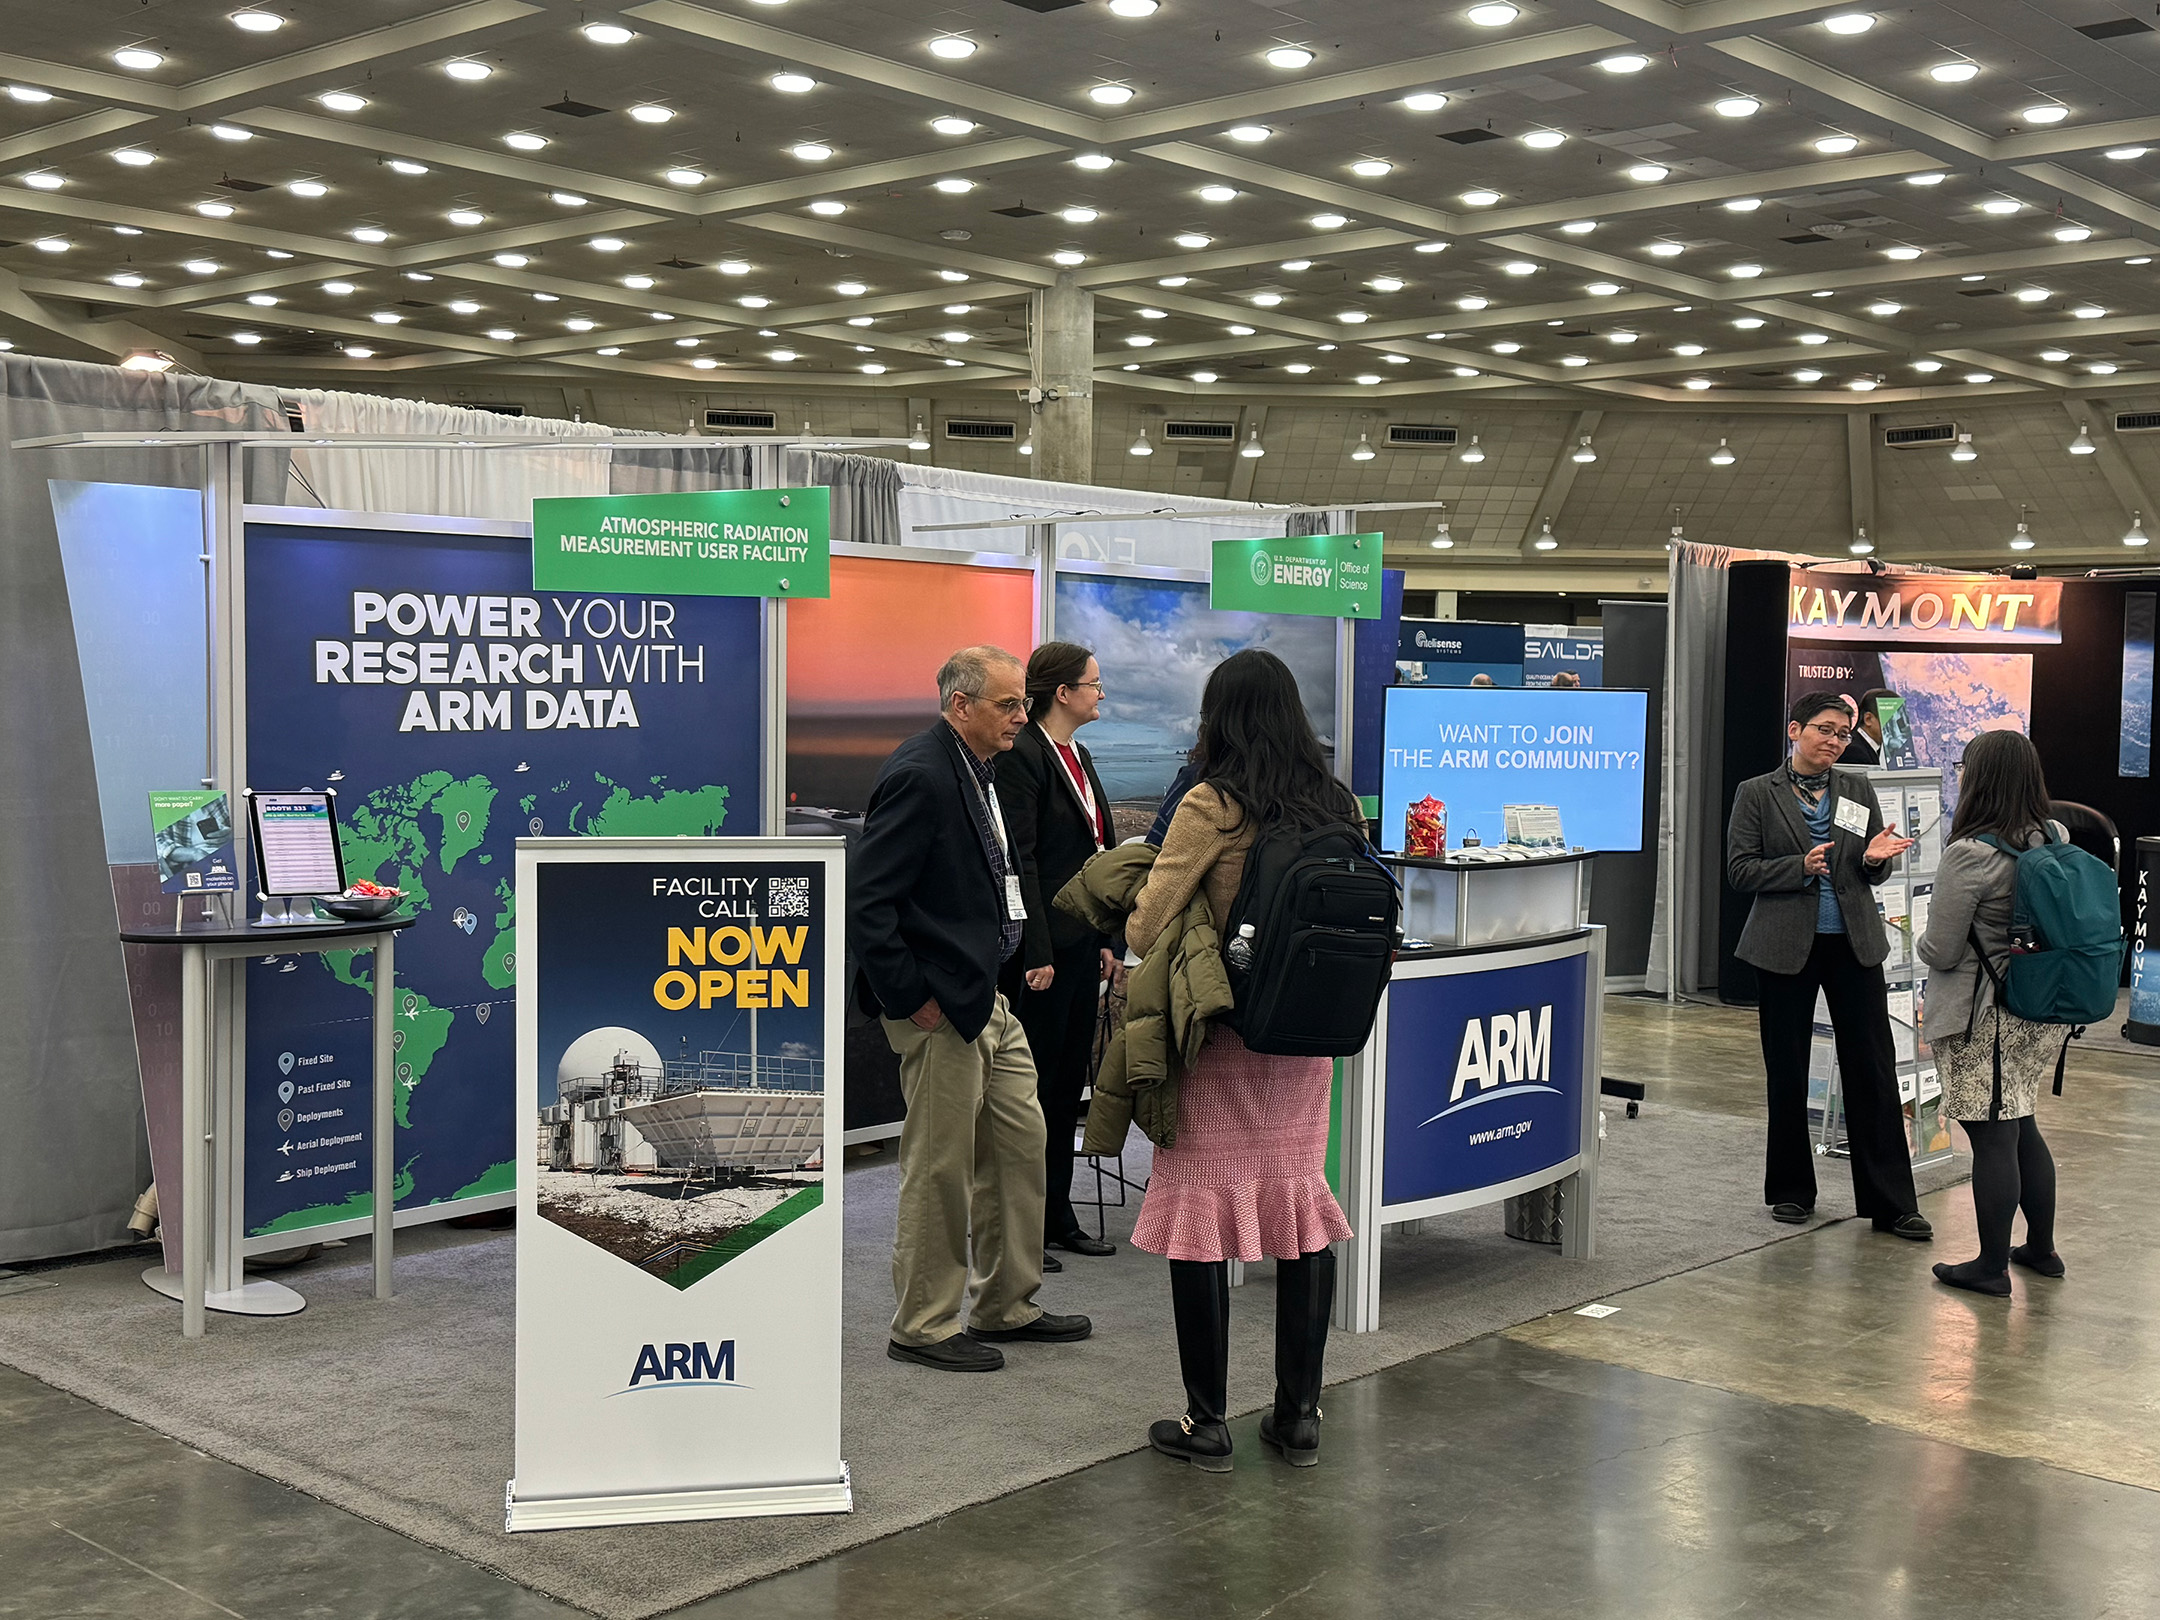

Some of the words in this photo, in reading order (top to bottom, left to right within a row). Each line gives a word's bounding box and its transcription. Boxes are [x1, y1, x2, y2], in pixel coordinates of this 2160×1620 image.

[600, 516, 719, 539] ATMOSPHERIC
[724, 523, 809, 543] RADIATION
[560, 535, 693, 558] MEASUREMENT
[698, 542, 739, 560] USER
[743, 544, 808, 563] FACILITY
[1285, 556, 1319, 565] DEPARTMENT
[1340, 561, 1361, 574] Office
[1362, 563, 1370, 575] of
[1273, 563, 1333, 588] ENERGY
[1339, 577, 1368, 591] Science
[353, 591, 542, 638] POWER
[552, 597, 675, 639] YOUR
[1791, 584, 2034, 631] KAYMONT
[315, 639, 584, 685] RESEARCH
[595, 643, 704, 684] WITH
[1798, 665, 1835, 679] TRUSTED
[1836, 667, 1854, 680] BY:
[399, 690, 512, 732] ARM
[526, 689, 640, 731] DATA
[1439, 724, 1502, 744] WANT
[1508, 725, 1538, 744] TO
[1543, 725, 1593, 745] JOIN
[1389, 748, 1433, 768] THE
[1438, 749, 1488, 769] ARM
[1495, 750, 1640, 770] COMMUNITY?
[172, 801, 193, 809] paper?
[653, 877, 759, 896] FACILITY
[698, 900, 759, 918] CALL
[2133, 870, 2149, 988] KAYMONT
[667, 925, 809, 966] NOW
[653, 969, 809, 1011] OPEN
[298, 1055, 318, 1066] Fixed
[319, 1054, 334, 1063] Site
[1449, 1004, 1552, 1103] ARM
[298, 1085, 315, 1095] Past
[316, 1081, 336, 1092] Fixed
[337, 1079, 352, 1089] Site
[297, 1108, 344, 1123] Deployments
[297, 1138, 319, 1151] Aerial
[320, 1132, 363, 1148] Deployment
[1469, 1119, 1533, 1146] www.arm.gov
[296, 1168, 313, 1179] Ship
[314, 1160, 357, 1176] Deployment
[628, 1339, 735, 1387] ARM
